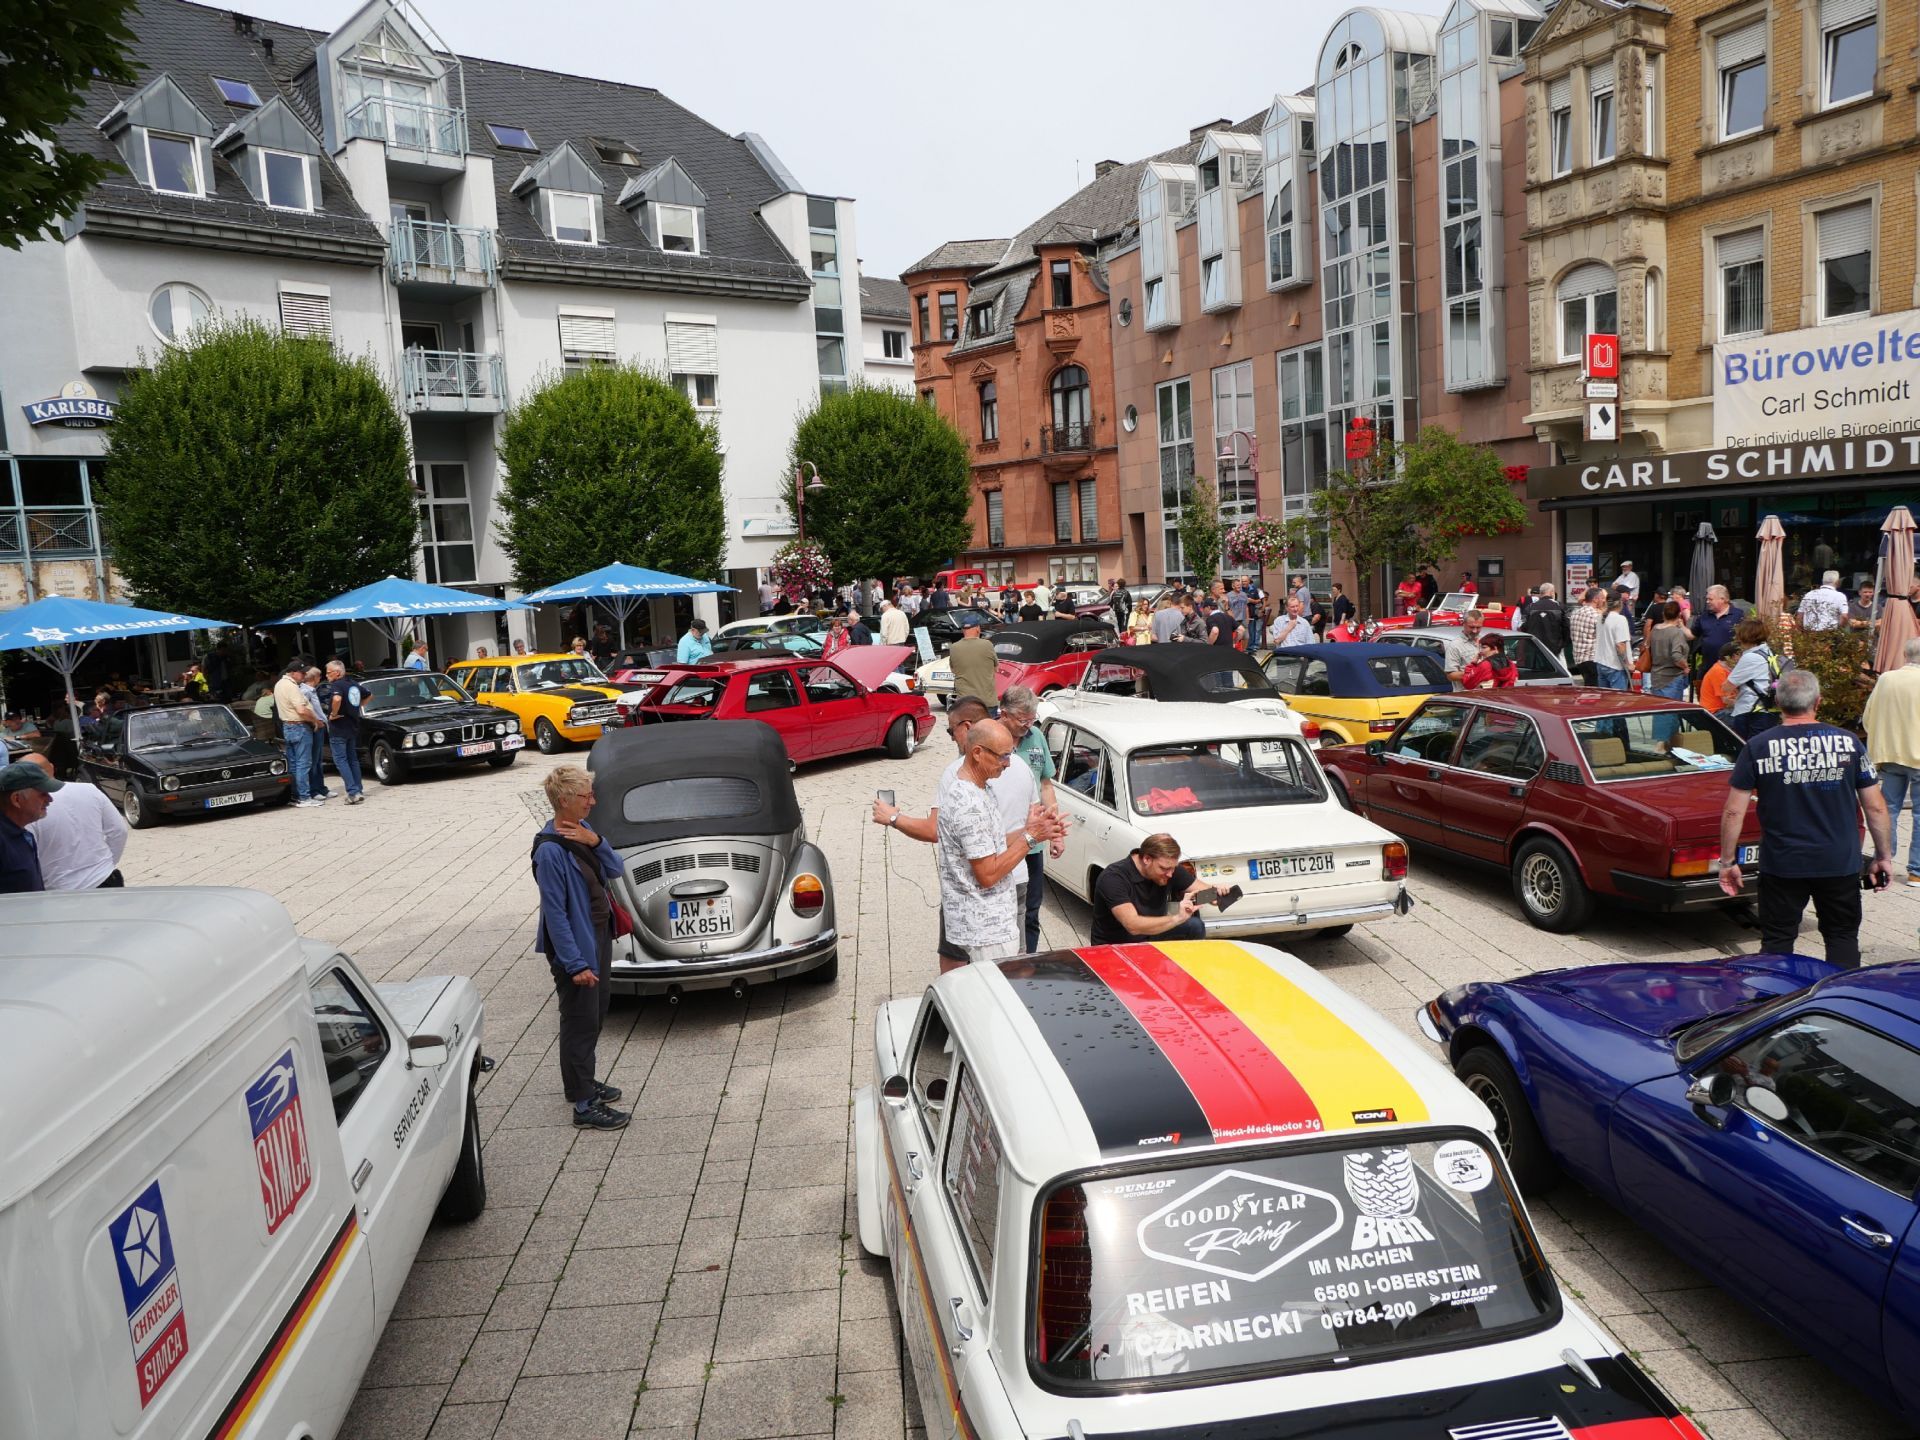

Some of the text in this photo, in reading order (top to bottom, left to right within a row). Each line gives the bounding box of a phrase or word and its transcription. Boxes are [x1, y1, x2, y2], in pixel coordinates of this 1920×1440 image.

[1761, 380, 1911, 417] Carl Schmidt
[1726, 435, 1751, 449] Der
[1754, 426, 1836, 446] individuelle
[1580, 436, 1920, 491] CARL SCHMIDT
[409, 598, 500, 610] KARLSBERG
[72, 615, 191, 635] KARLSBERG
[1768, 735, 1856, 758] DISCOVER
[1757, 757, 1783, 775] THE
[1787, 752, 1838, 771] OCEAN
[1783, 767, 1845, 785] SURFACE
[239, 794, 247, 802] 77
[1258, 859, 1281, 877] IGB
[1290, 857, 1307, 873] TC
[681, 901, 700, 918] AW
[675, 919, 696, 937] KK
[393, 1077, 432, 1150] SERVICE CAR
[1353, 1111, 1387, 1120] KONI
[1138, 1136, 1174, 1146] KONI
[256, 1099, 311, 1228] SIMCA
[1114, 1178, 1177, 1195] DUNLOP
[1184, 1219, 1302, 1262] Racing
[1308, 1246, 1415, 1276] IM NACHEN
[1314, 1263, 1482, 1303] 6580 I-OBERSTEIN
[1440, 1284, 1499, 1302] DUNLOP
[1126, 1279, 1232, 1316] REIFEN
[1450, 1295, 1489, 1307] MOTORSPORT
[132, 1282, 179, 1345] CHRYSLER
[1320, 1300, 1418, 1330] 06784-200
[1135, 1310, 1303, 1358] CZARNECKI
[143, 1327, 183, 1394] SIMCA
